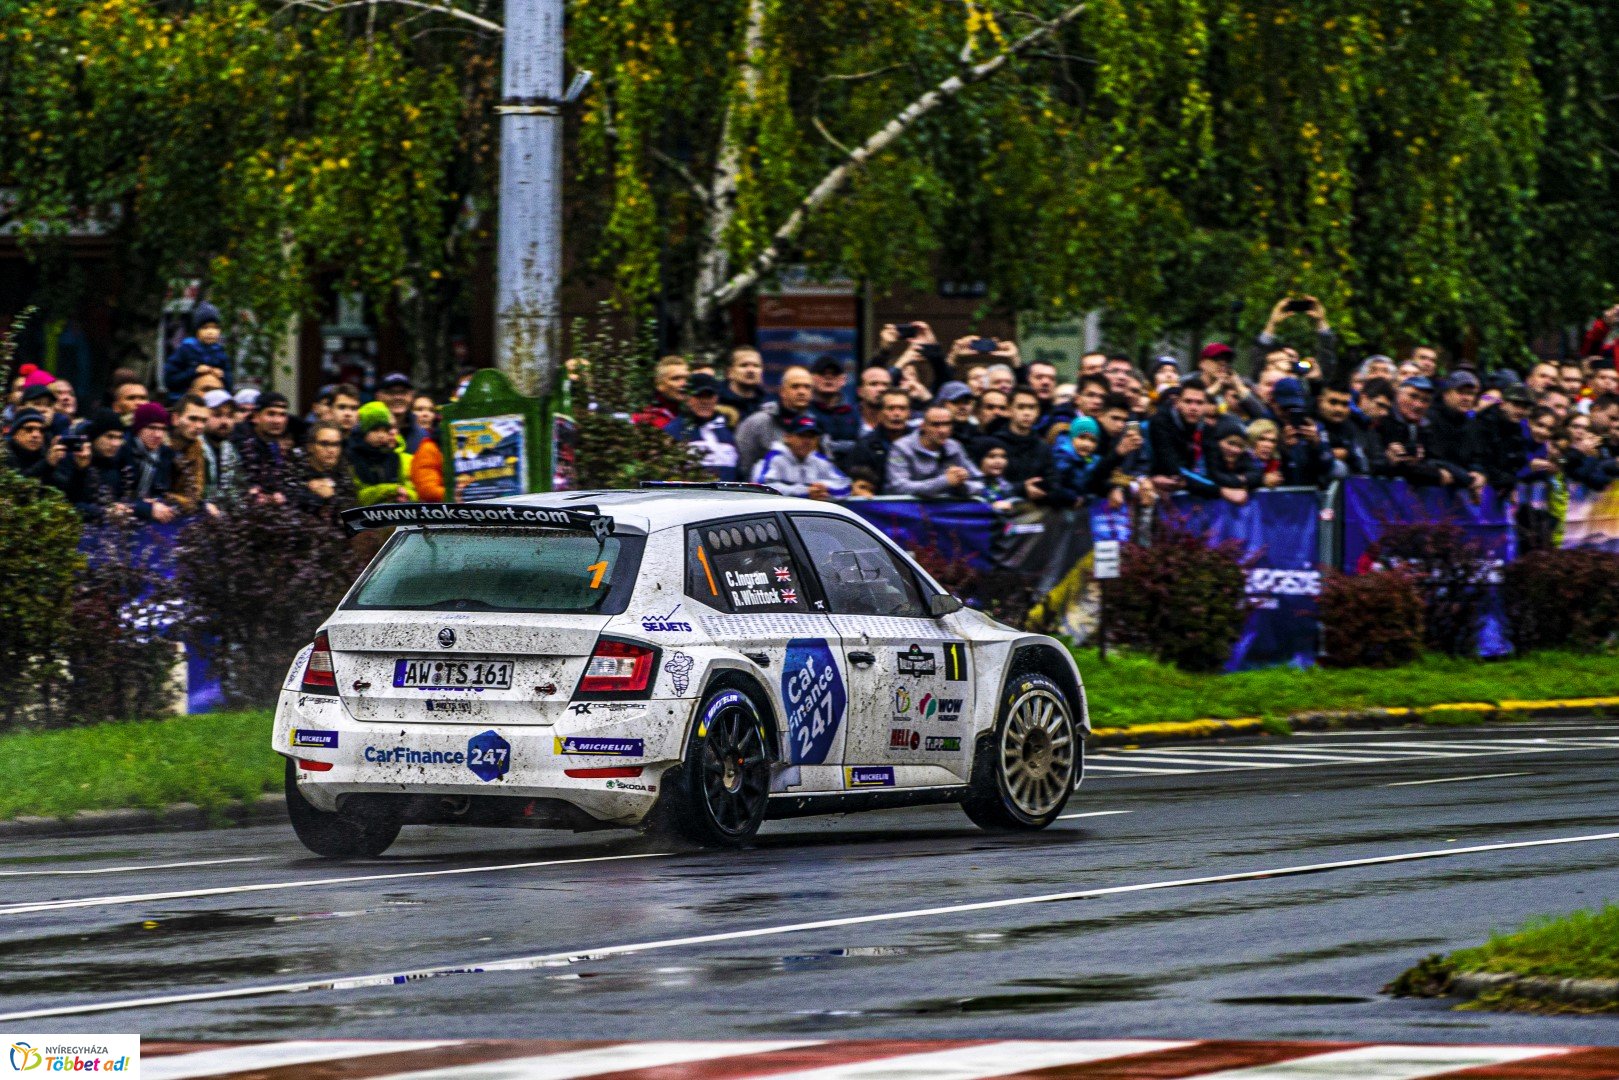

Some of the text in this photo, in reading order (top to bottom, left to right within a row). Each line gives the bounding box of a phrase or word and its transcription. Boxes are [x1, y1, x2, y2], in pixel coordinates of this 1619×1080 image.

[362, 505, 571, 524] www.toksport.com
[586, 560, 609, 589] 1
[725, 570, 769, 588] C.Ingram
[642, 622, 692, 632] SEAJETS
[950, 644, 959, 680] 1
[405, 662, 508, 685] AW TS 161
[787, 655, 816, 704] Car
[789, 664, 834, 733] Finance
[938, 699, 963, 713] WOW
[797, 691, 834, 759] 247
[364, 746, 508, 765] CarFinance 247
[579, 743, 634, 751] MICHELIN
